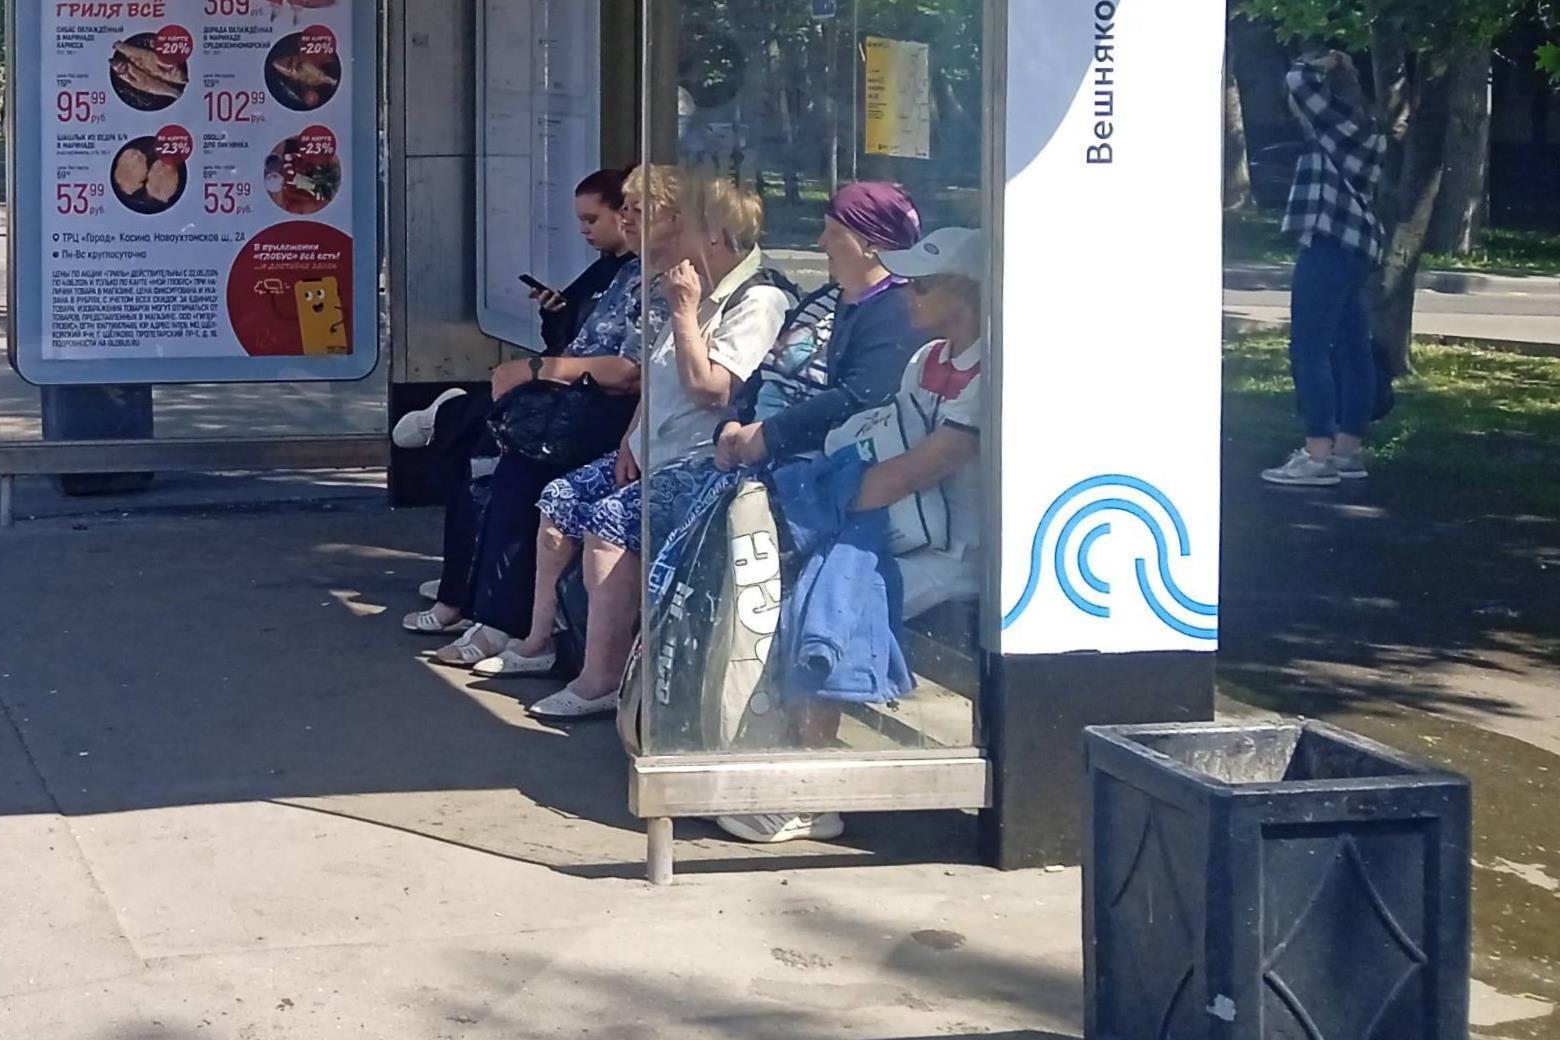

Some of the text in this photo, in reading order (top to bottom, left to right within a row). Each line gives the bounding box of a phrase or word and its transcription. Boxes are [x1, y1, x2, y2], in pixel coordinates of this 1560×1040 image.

[56, 0, 166, 20] ГРИЛЯ ВСЁ
[156, 42, 190, 55] -20%
[300, 42, 334, 55] -20%
[155, 142, 191, 155] -23%
[300, 142, 334, 155] -23%
[62, 233, 80, 243] ТРЦ
